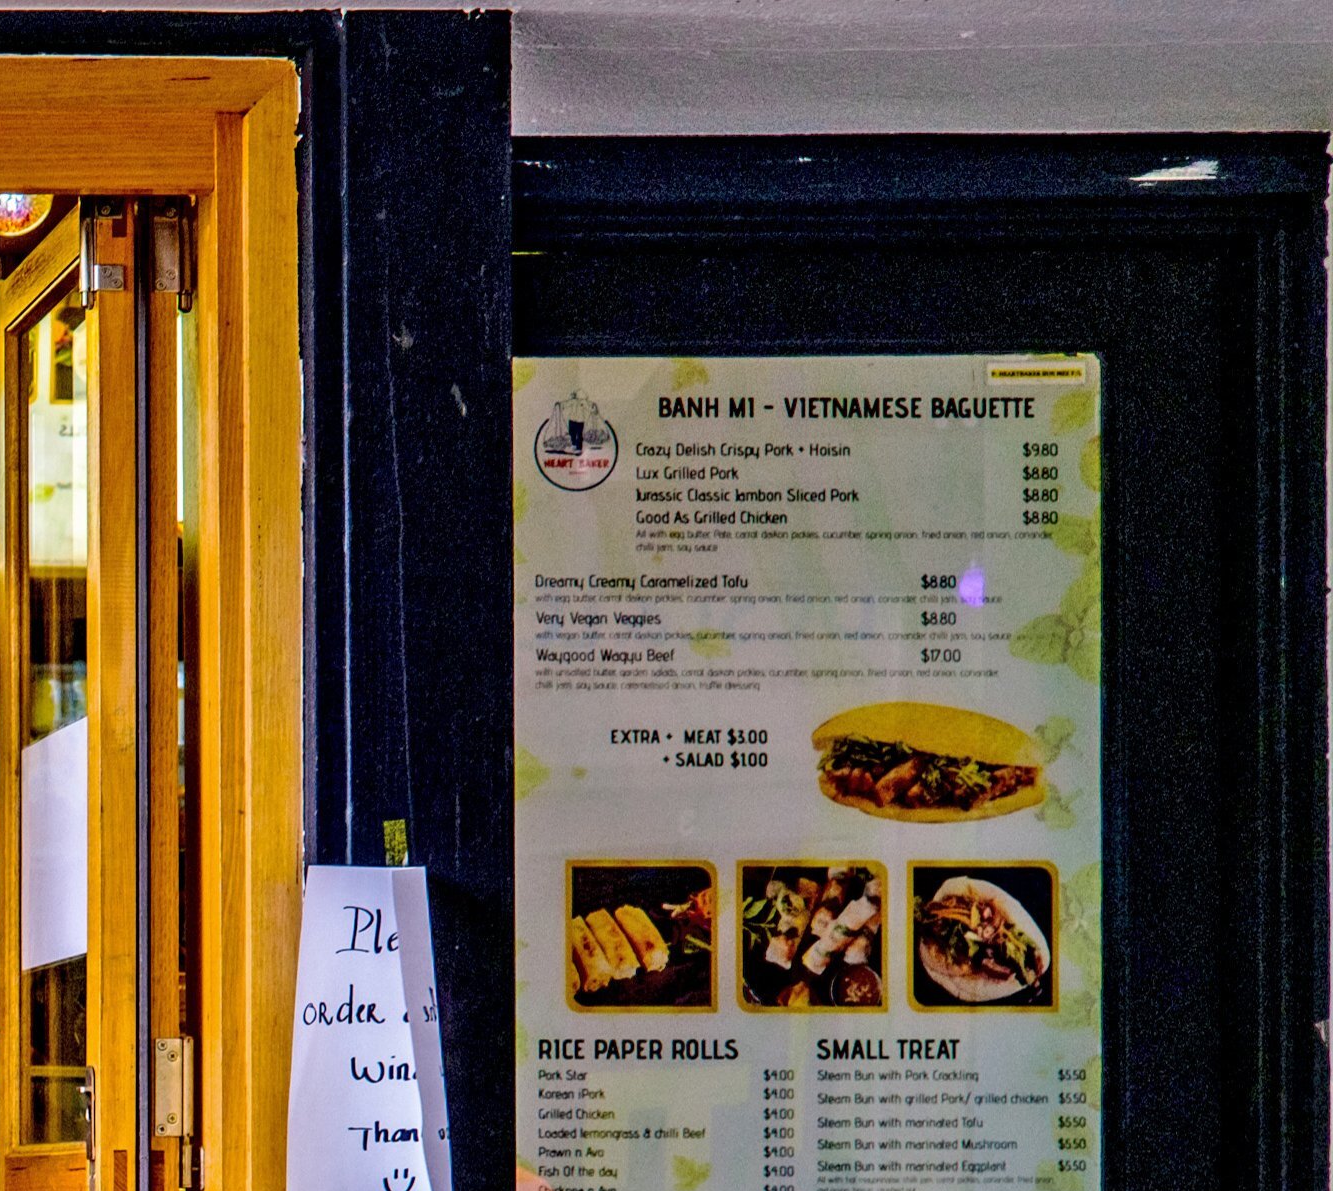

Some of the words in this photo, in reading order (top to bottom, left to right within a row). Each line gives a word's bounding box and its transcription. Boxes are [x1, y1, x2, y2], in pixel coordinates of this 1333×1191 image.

[658, 396, 719, 419] BANH
[729, 396, 755, 419] MI
[783, 396, 922, 419] VIETNAMESE
[931, 396, 1035, 419] BAGUETTE
[538, 1038, 585, 1060] RICE
[594, 1038, 663, 1060] PAPER
[671, 1038, 739, 1061] ROLLS
[816, 1038, 890, 1061] SMALL
[896, 1038, 960, 1060] TREAT
[351, 1056, 417, 1083] Win
